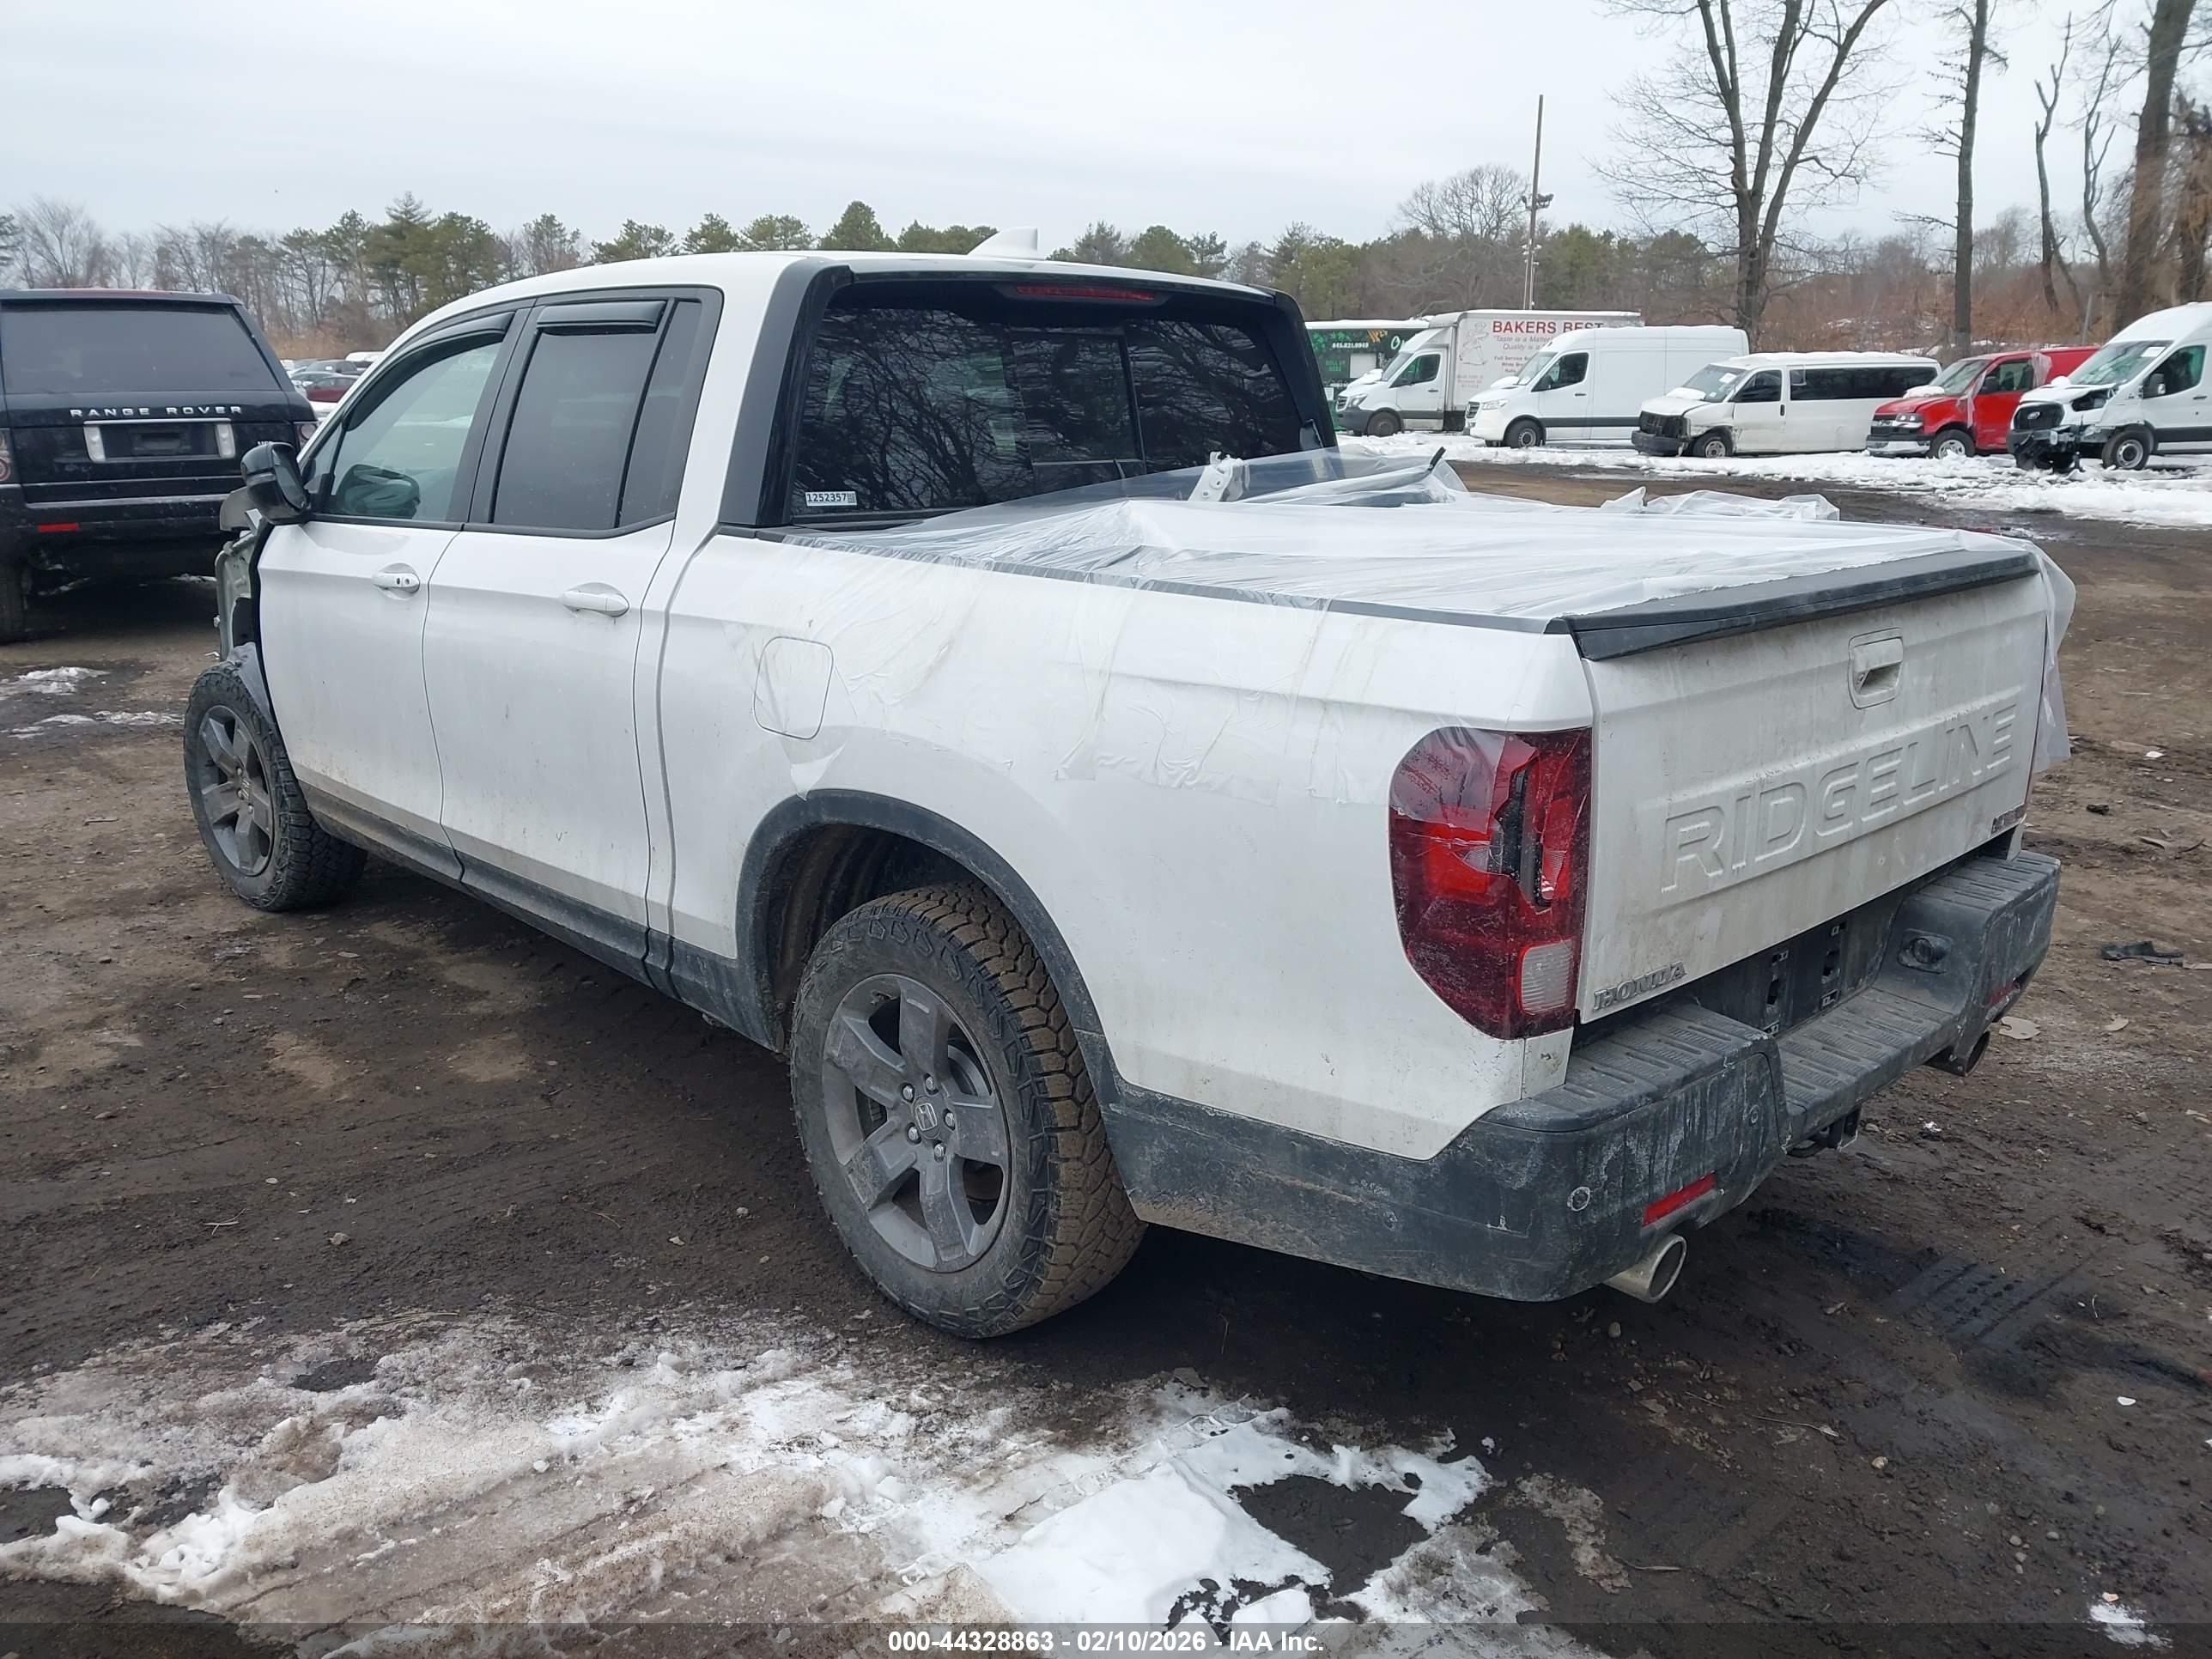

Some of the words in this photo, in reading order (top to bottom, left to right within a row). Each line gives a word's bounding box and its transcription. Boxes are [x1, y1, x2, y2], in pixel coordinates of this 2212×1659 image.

[1492, 320, 1557, 334] BAKERS
[70, 407, 150, 417] RANGE
[166, 405, 243, 416] ROVER
[806, 493, 847, 502] 1252357
[1662, 703, 2016, 893] RIDGELINE
[1593, 961, 1686, 1012] HONDA
